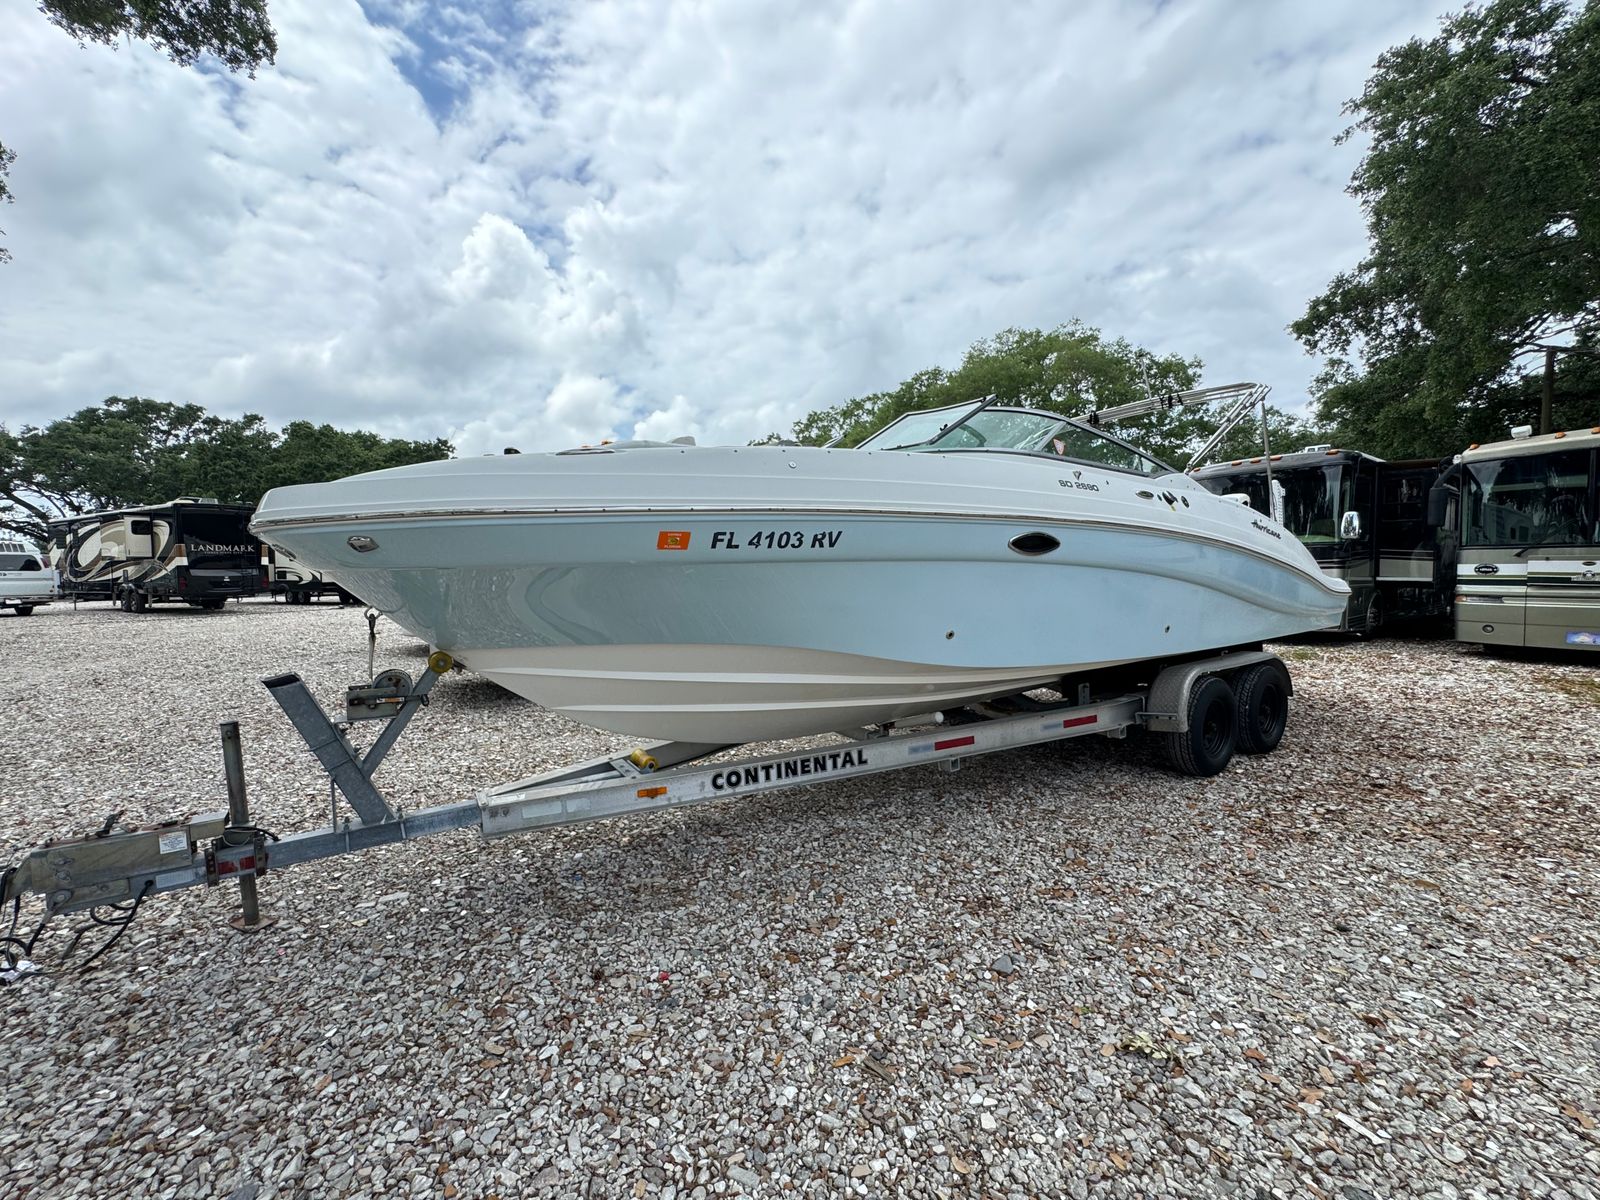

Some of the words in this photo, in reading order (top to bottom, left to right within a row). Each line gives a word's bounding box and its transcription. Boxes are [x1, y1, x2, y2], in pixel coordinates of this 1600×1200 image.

[1250, 519, 1282, 539] Hurricane
[191, 544, 255, 552] LANDMARK
[710, 531, 740, 549] FL
[748, 530, 805, 549] 4103
[810, 530, 843, 549] RV
[711, 749, 868, 790] CONTINENTAL
